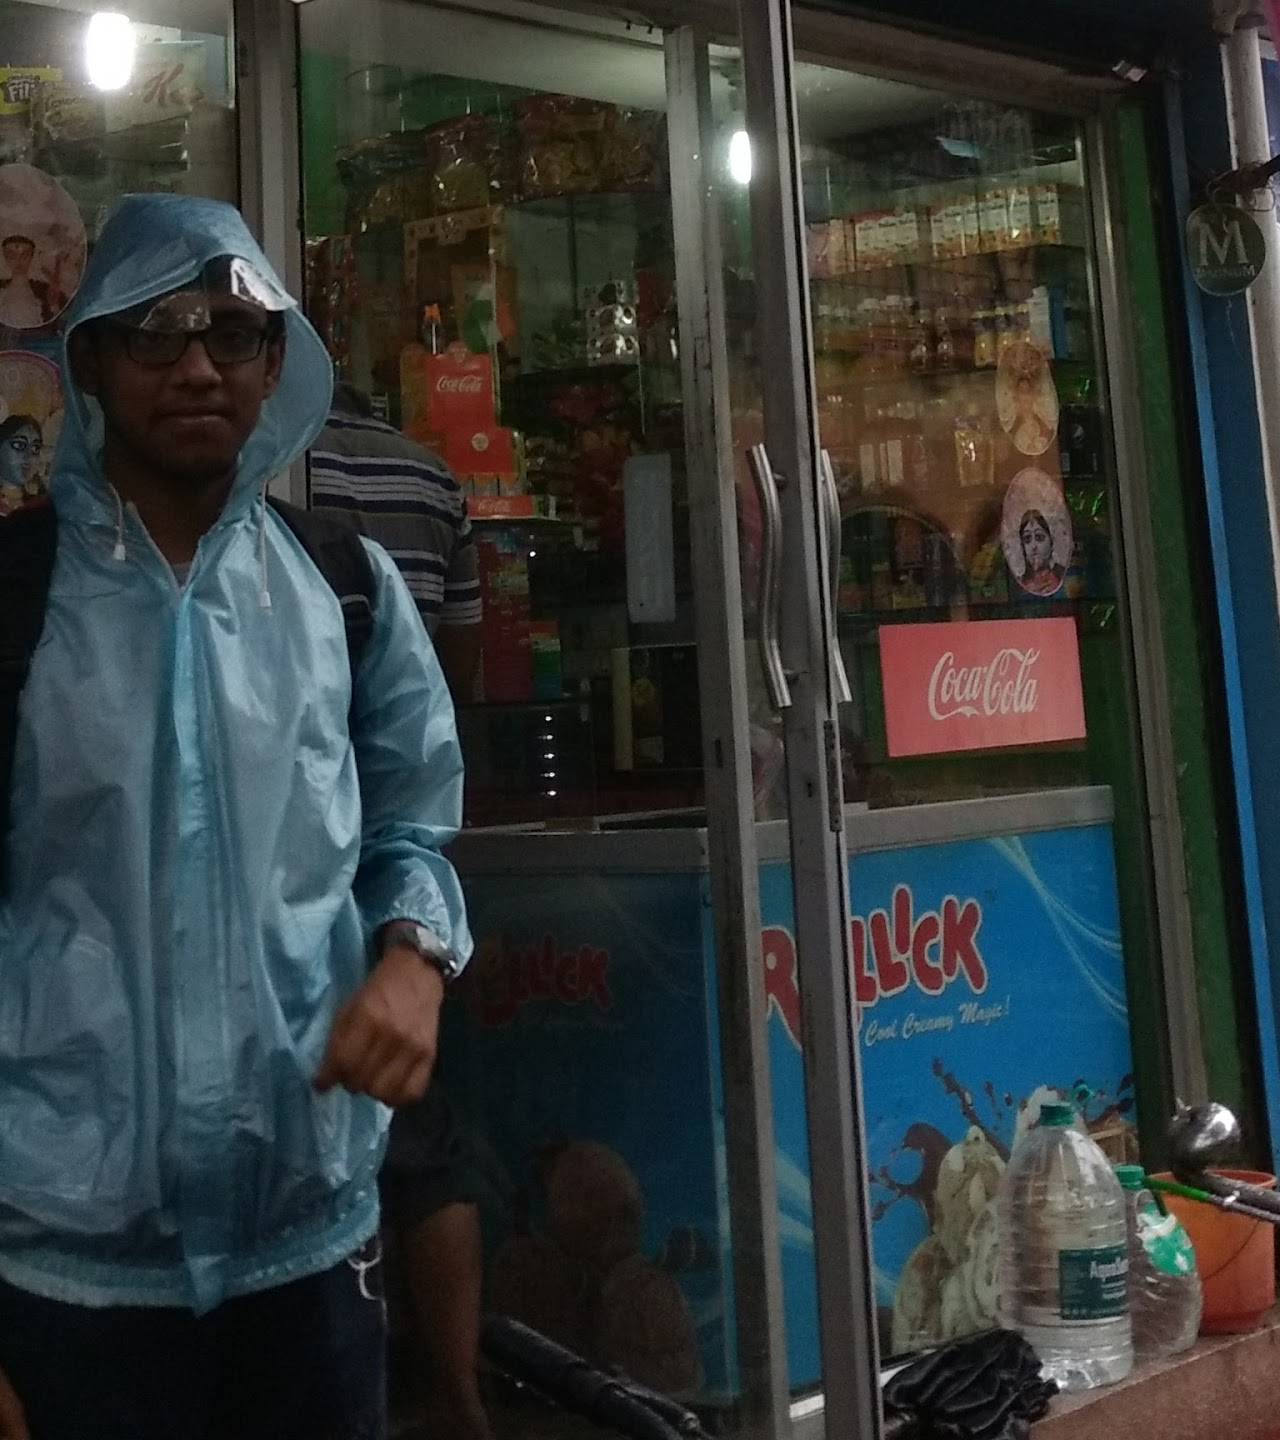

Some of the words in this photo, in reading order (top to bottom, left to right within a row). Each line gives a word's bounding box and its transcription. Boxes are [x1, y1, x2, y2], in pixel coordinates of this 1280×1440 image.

[1199, 220, 1250, 266] M
[926, 646, 1041, 722] Coca-Cola
[761, 884, 988, 1052] RLLICK
[902, 1012, 955, 1040] Creamy
